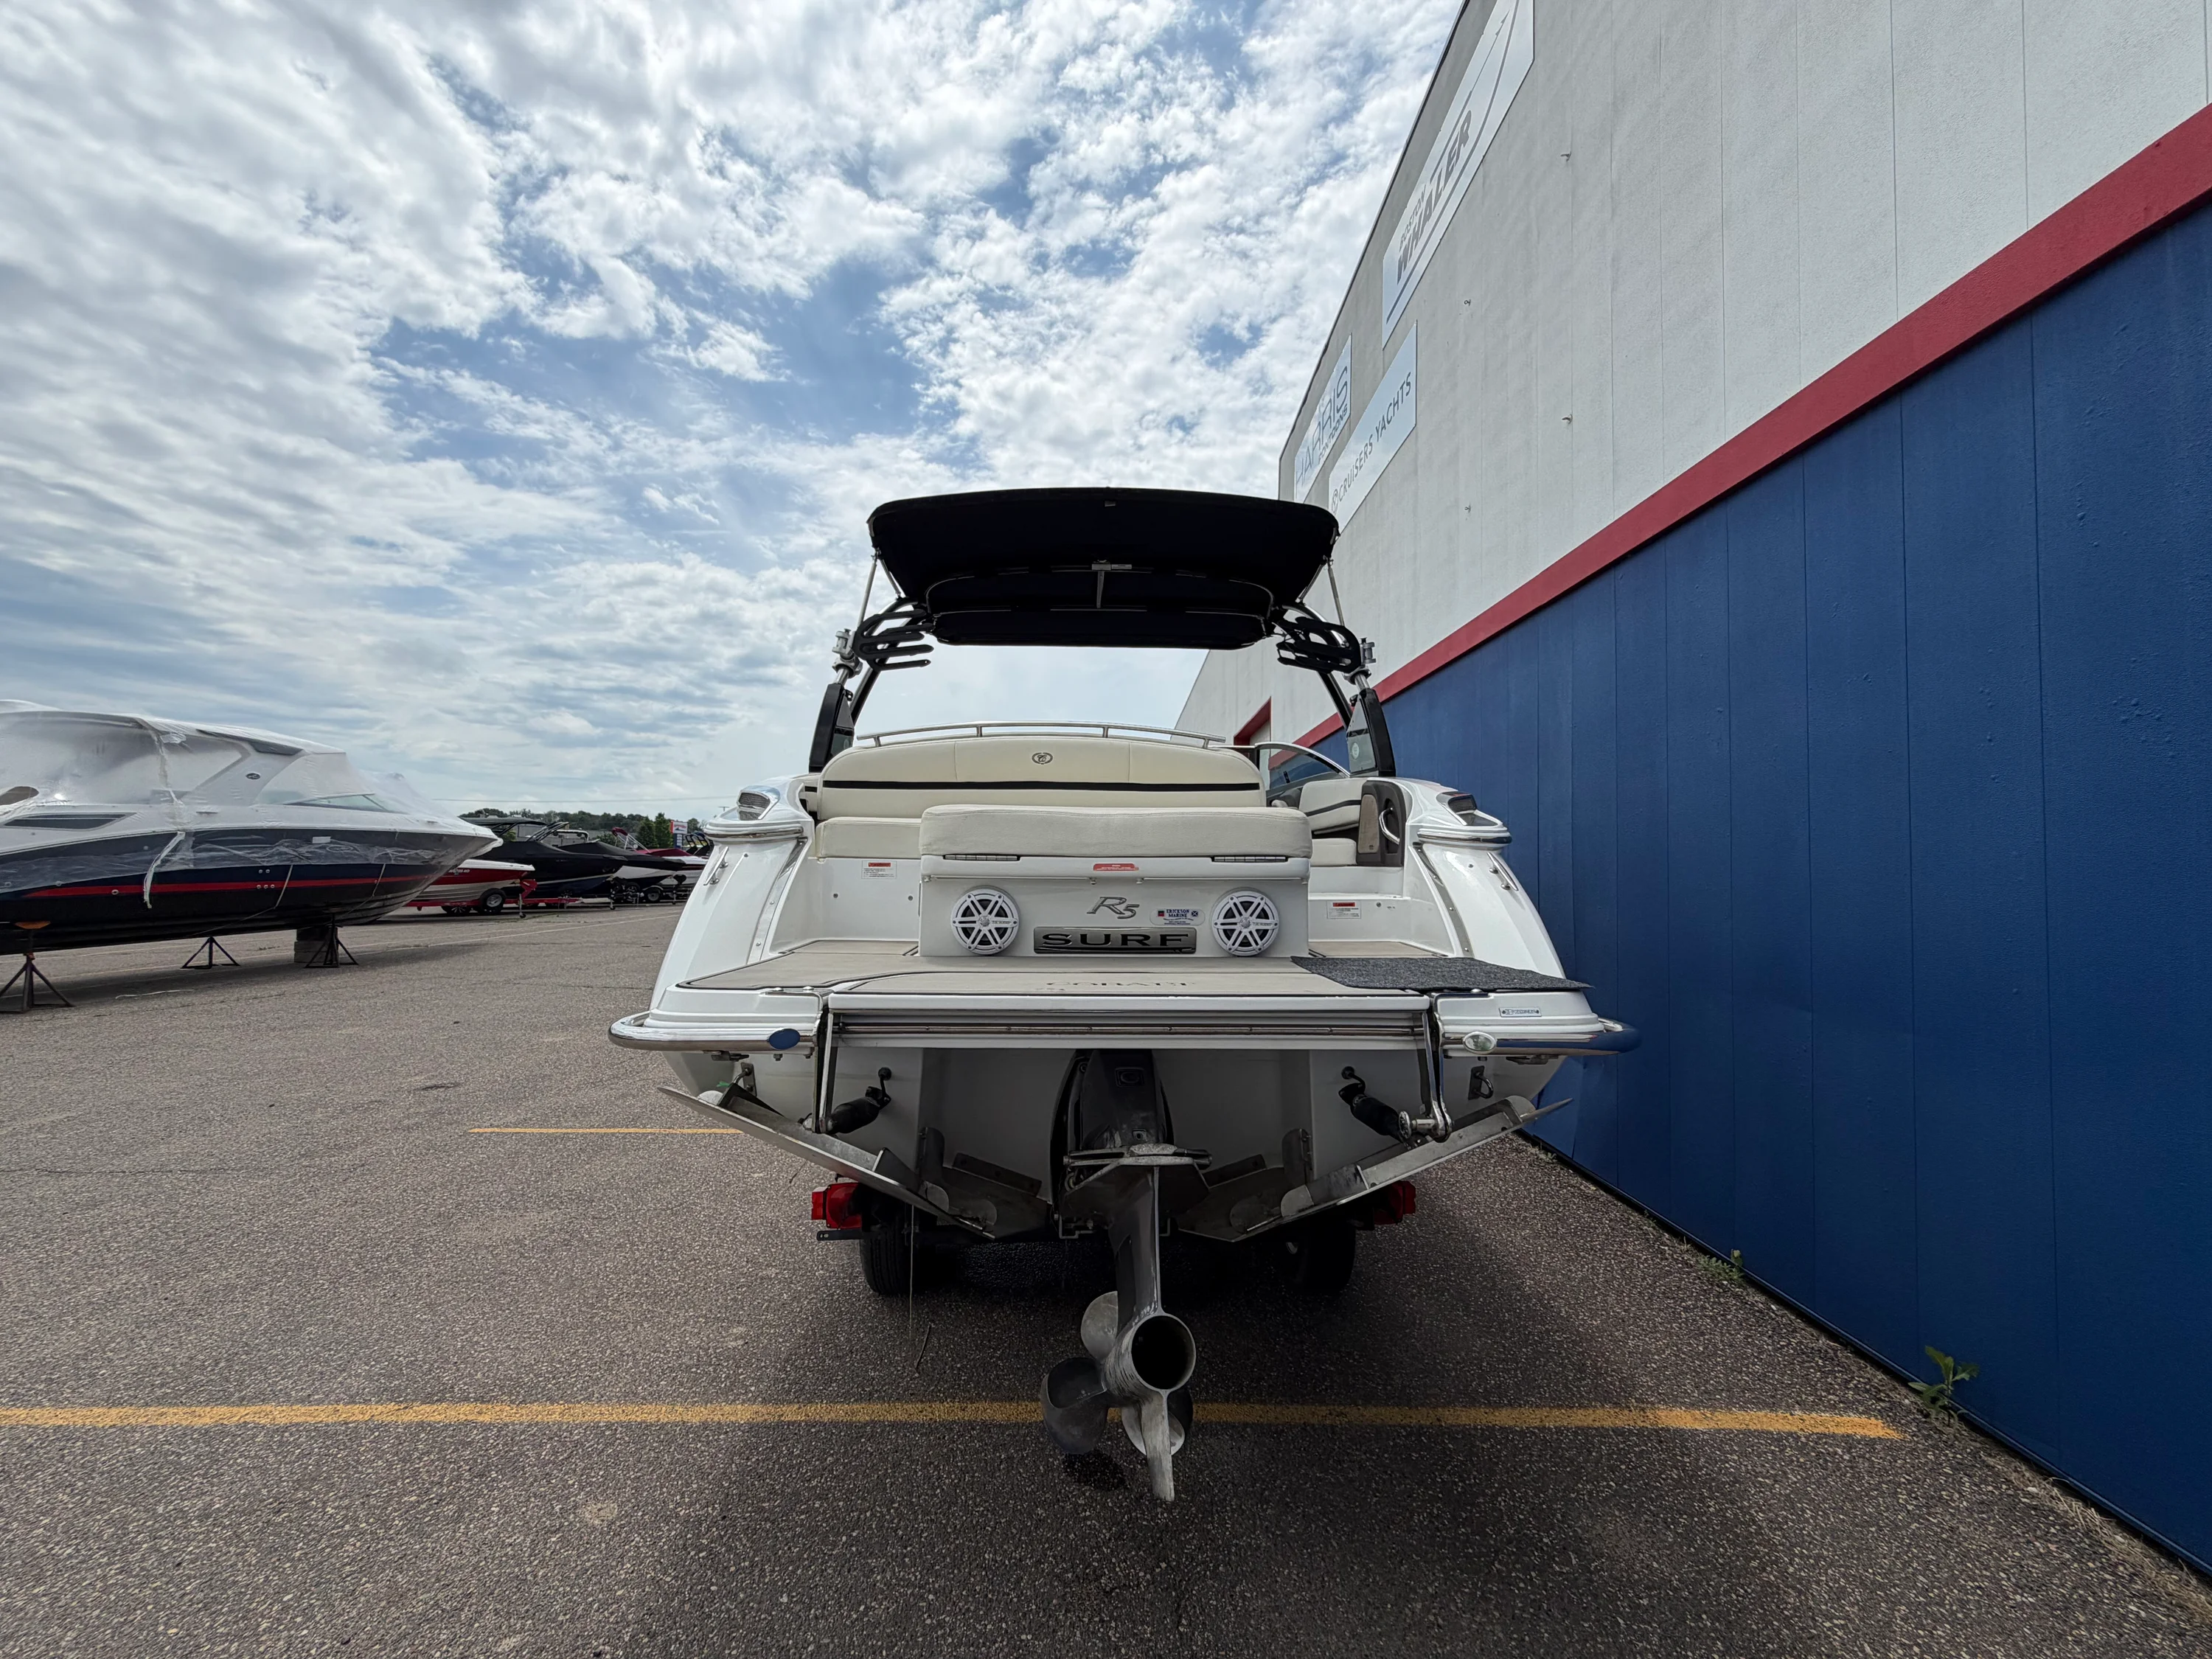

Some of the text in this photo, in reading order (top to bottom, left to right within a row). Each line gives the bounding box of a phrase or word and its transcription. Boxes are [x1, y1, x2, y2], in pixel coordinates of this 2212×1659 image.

[1397, 109, 1472, 286] WHALER
[1399, 184, 1427, 252] BOSTON
[1295, 366, 1348, 499] HARRIS
[1318, 403, 1348, 466] PONTOONS
[1338, 372, 1411, 503] CRUISERS YACHTS
[1042, 933, 1189, 947] SURF
